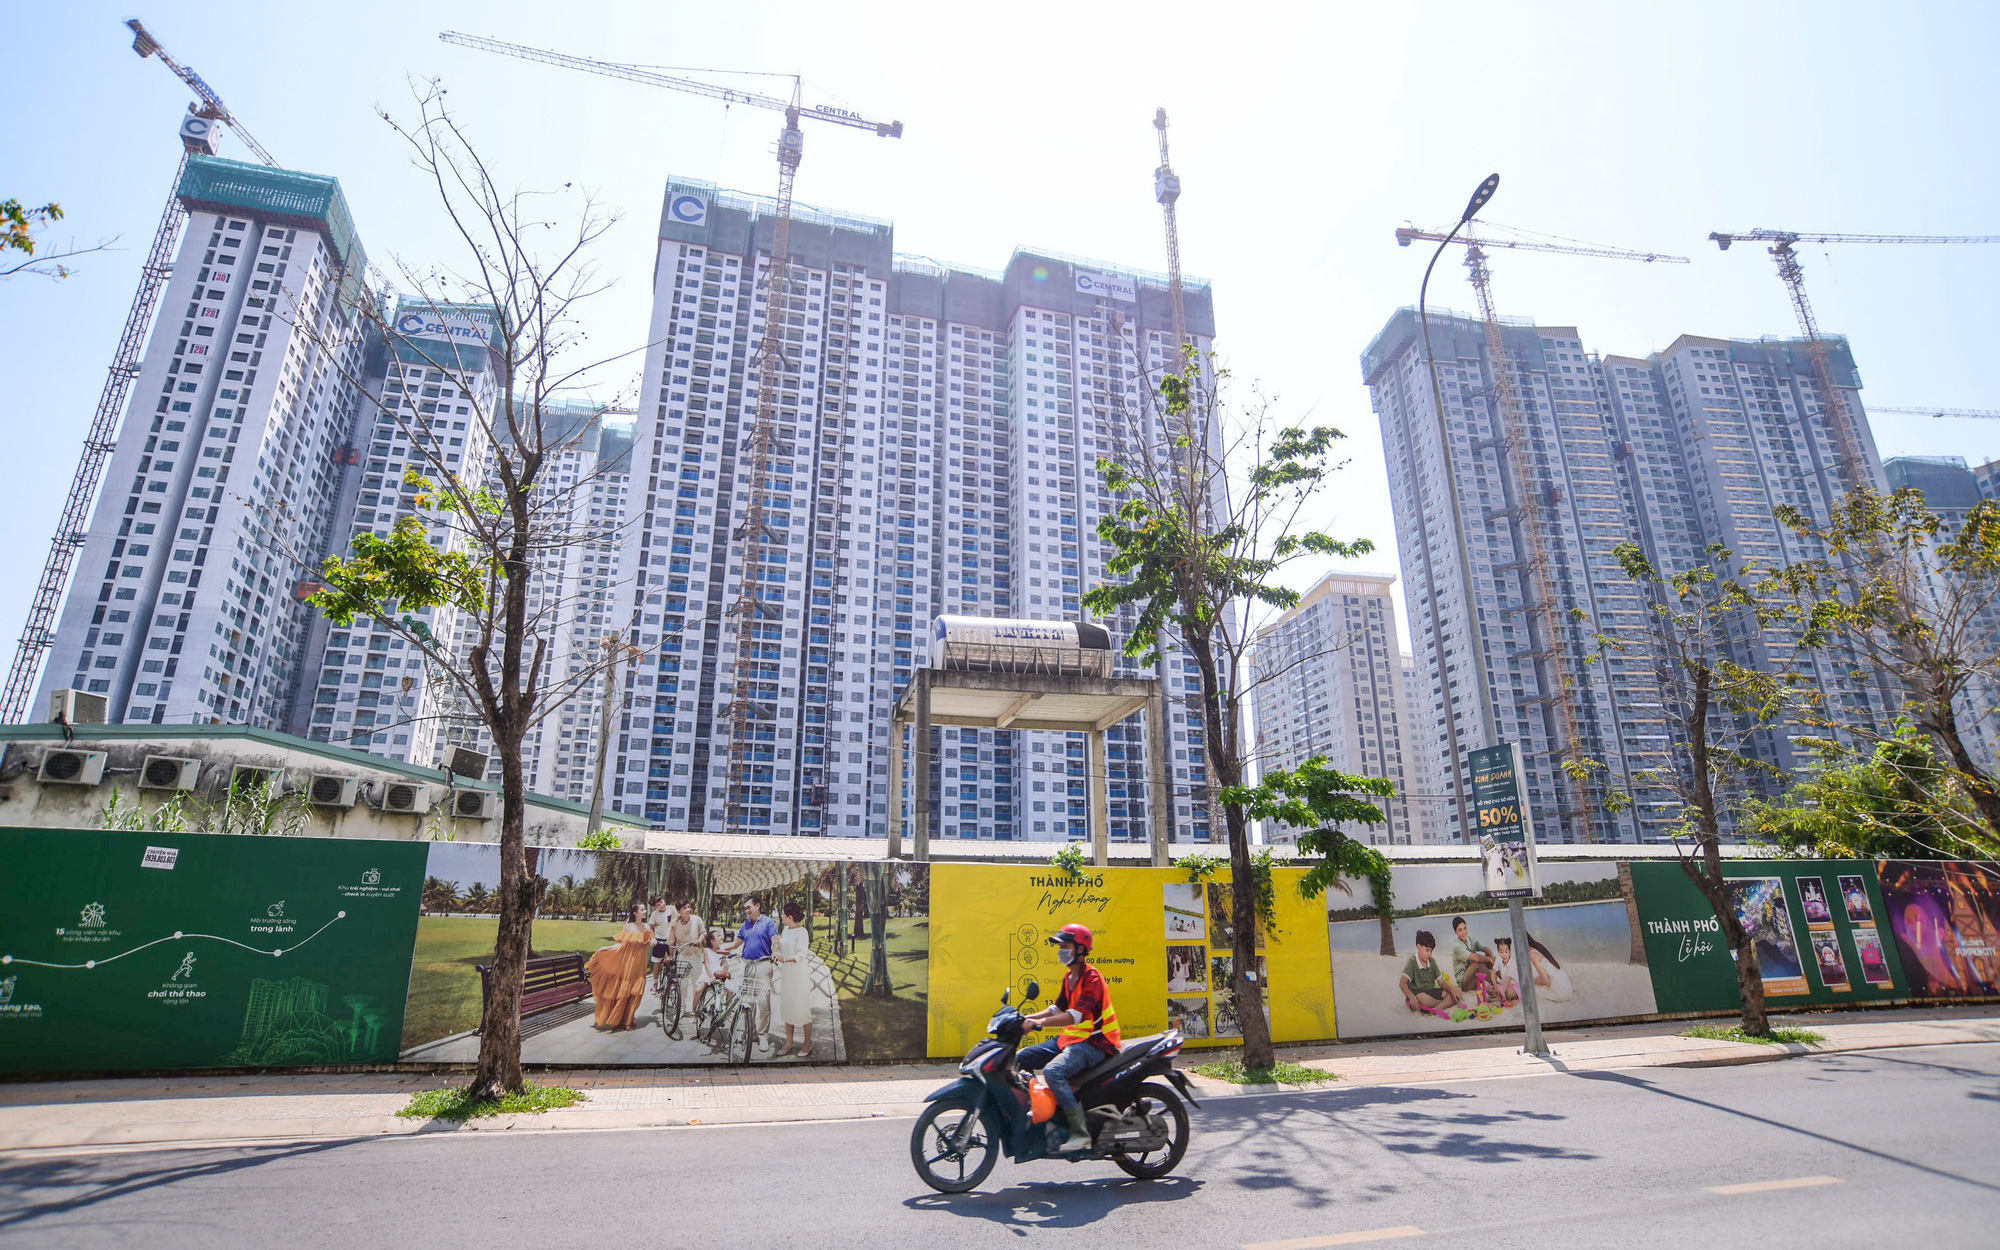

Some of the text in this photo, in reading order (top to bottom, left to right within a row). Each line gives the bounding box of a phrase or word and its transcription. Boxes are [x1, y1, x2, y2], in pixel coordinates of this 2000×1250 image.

[815, 104, 862, 120] CENTRAL
[215, 273, 227, 282] 30
[1094, 281, 1134, 295] CENTRAL
[205, 309, 216, 318] 28
[425, 322, 489, 340] CENTRAL
[193, 345, 205, 354] 26
[1491, 769, 1512, 781] DOANH
[1480, 805, 1518, 827] 50%
[1030, 873, 1104, 888] THÀNH PHỐ
[1076, 888, 1112, 913] dưỡng
[250, 925, 294, 934] trong lành
[1648, 914, 1719, 934] THÀNH PHỐ
[1693, 932, 1714, 957] hội
[1096, 956, 1113, 965] điểm
[1114, 956, 1135, 966] nướng
[1112, 976, 1123, 984] tập
[147, 989, 207, 998] chơi thể thao
